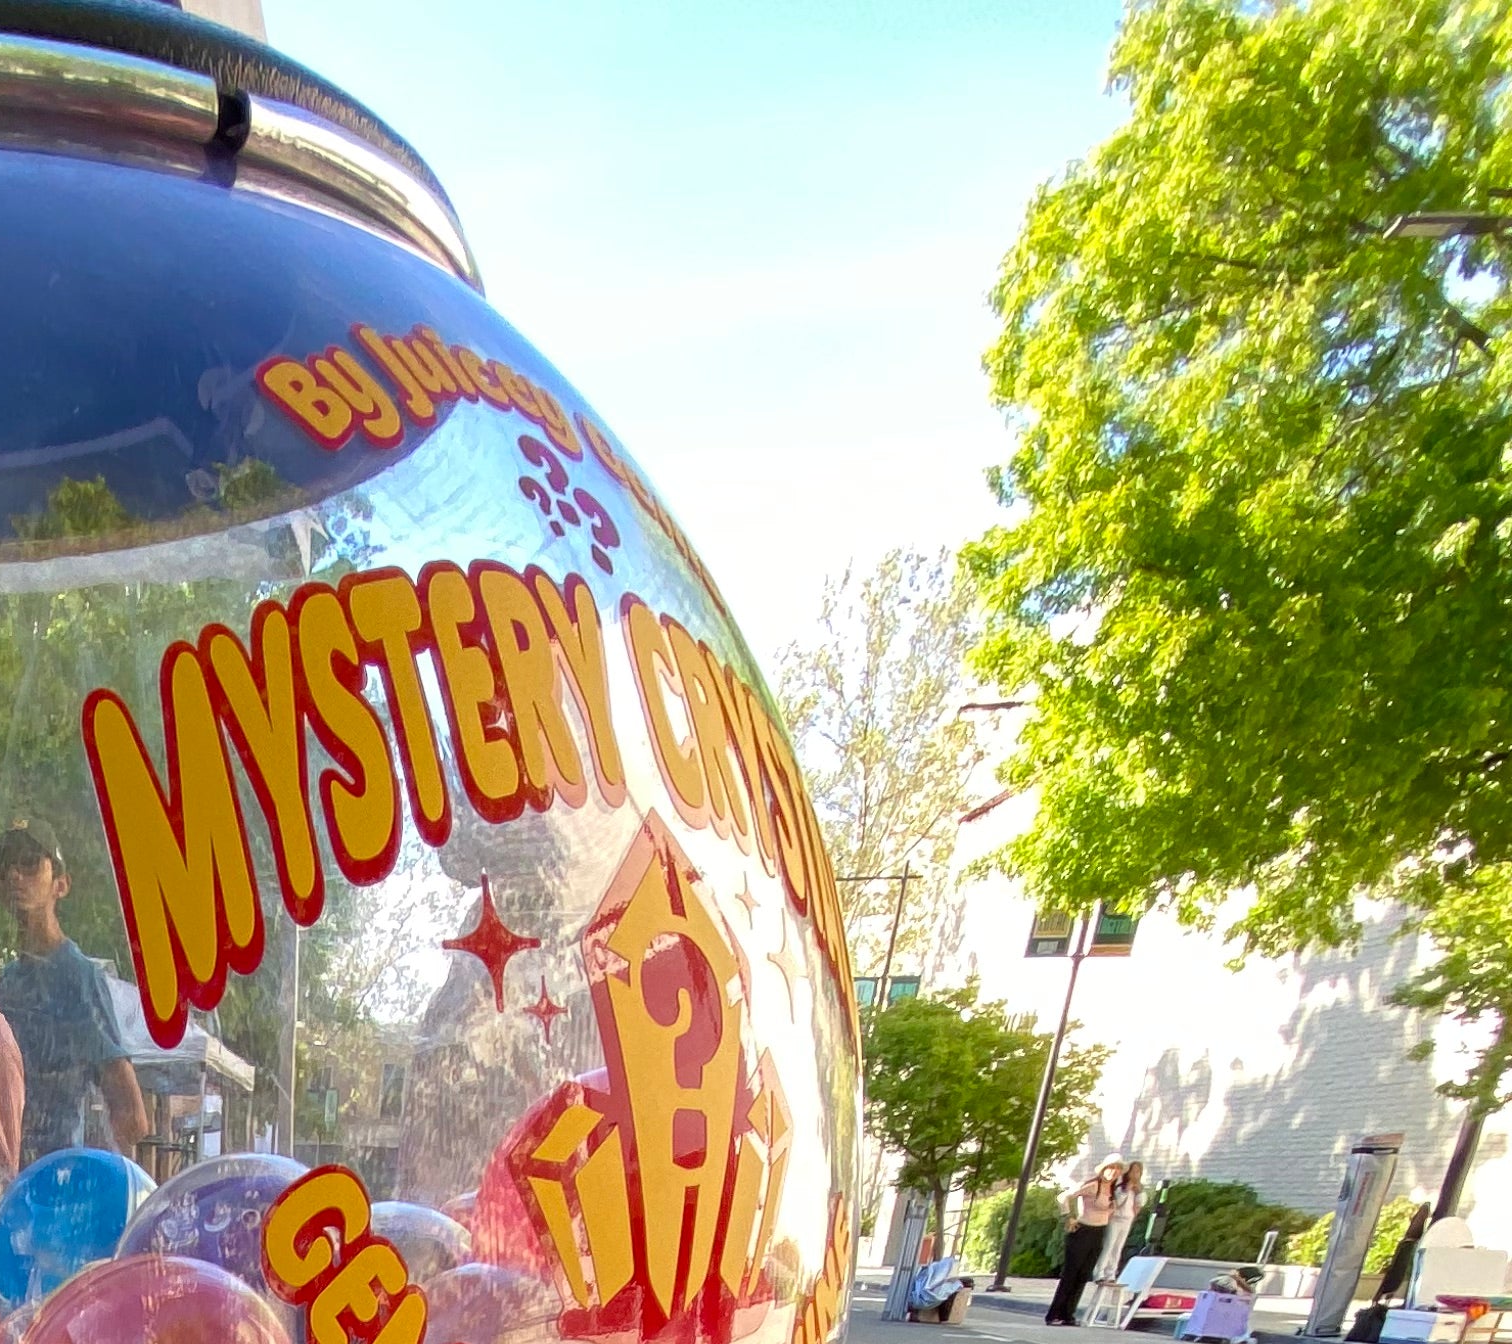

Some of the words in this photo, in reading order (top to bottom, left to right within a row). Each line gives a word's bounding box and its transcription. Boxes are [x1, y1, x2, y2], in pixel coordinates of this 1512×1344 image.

[255, 343, 405, 451] By
[348, 321, 584, 461] Juicey
[81, 559, 627, 1050] MYSTERY
